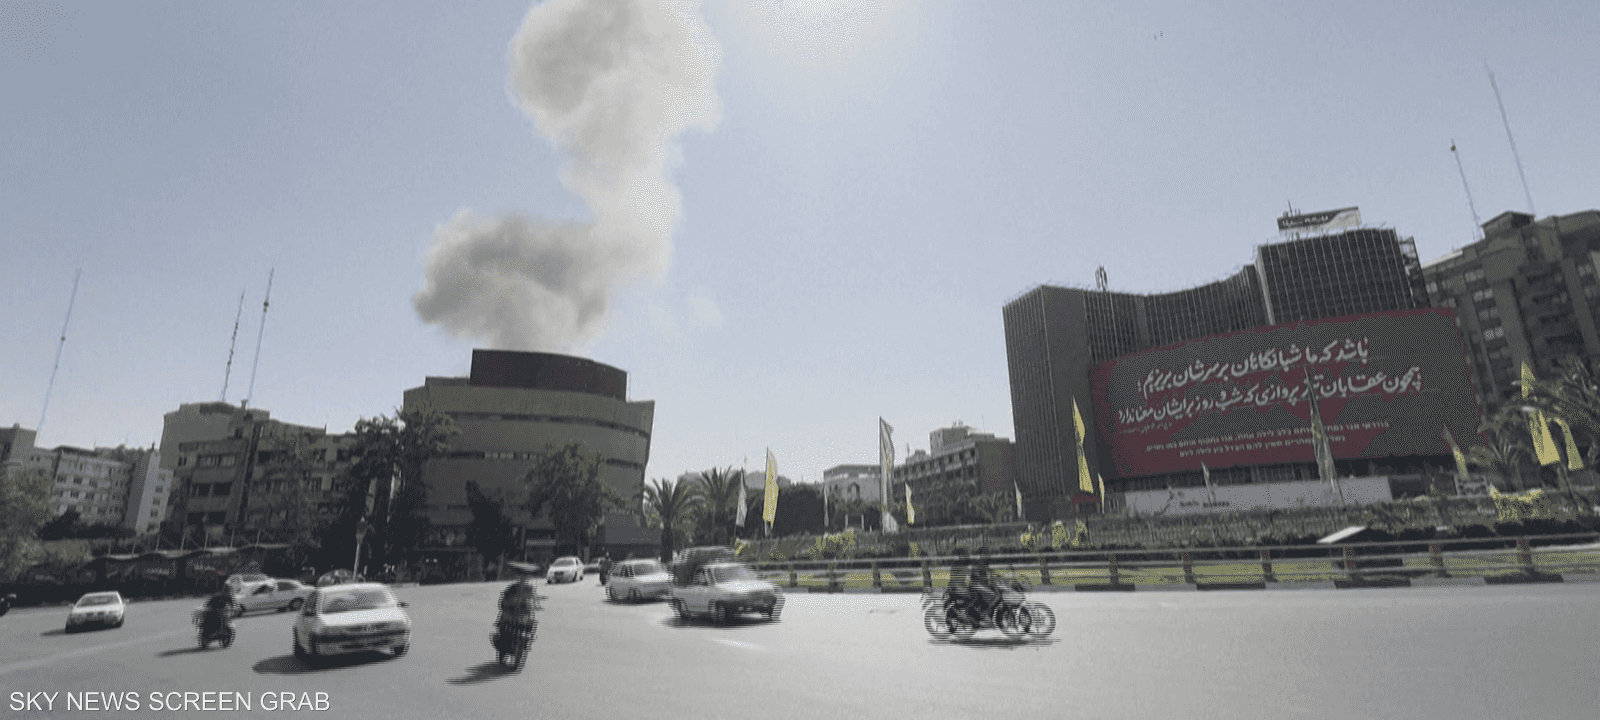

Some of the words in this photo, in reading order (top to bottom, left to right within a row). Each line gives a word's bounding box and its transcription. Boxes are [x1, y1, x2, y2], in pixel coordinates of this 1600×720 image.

[1305, 345, 1318, 364] ما
[1319, 339, 1338, 364] که
[1333, 336, 1368, 364] باشد
[1243, 383, 1259, 404] که
[1320, 371, 1387, 398] عقابان
